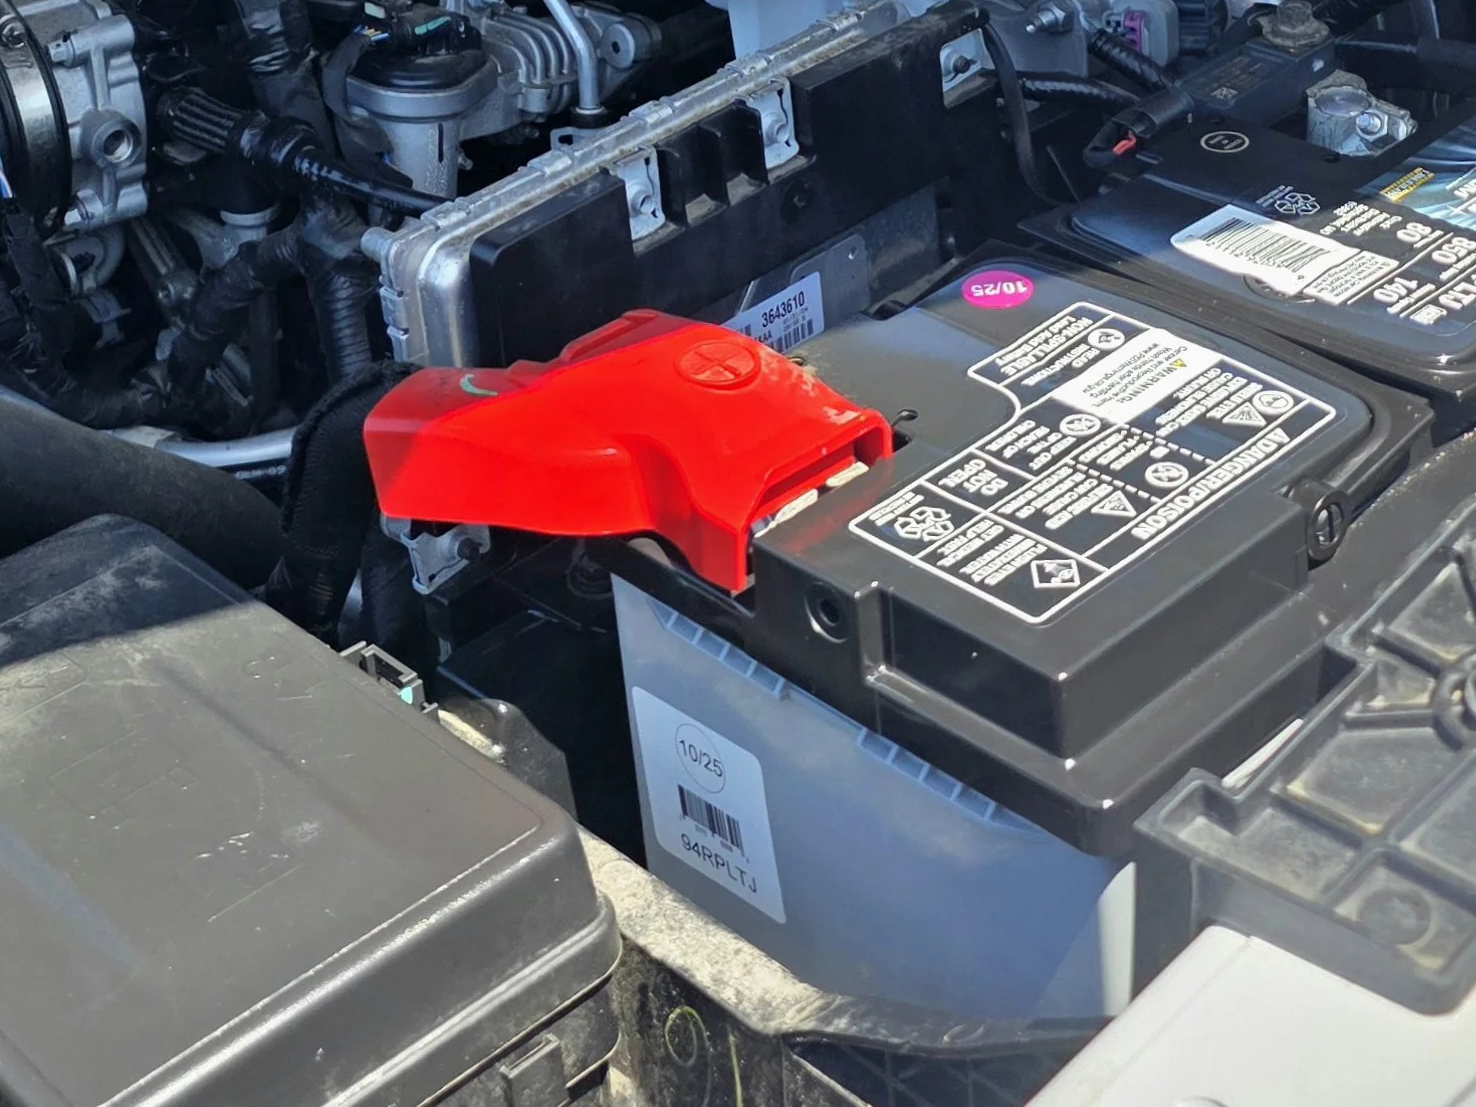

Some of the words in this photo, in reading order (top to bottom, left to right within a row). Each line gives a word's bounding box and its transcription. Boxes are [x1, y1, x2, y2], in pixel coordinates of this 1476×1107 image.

[1396, 222, 1432, 244] 80
[1431, 237, 1476, 264] 850
[970, 280, 1028, 297] 10/25
[1373, 277, 1418, 304] 140
[761, 291, 805, 328] 3643610
[997, 316, 1094, 376] NON-SPILLABLE
[958, 468, 998, 493] NOT
[977, 476, 1010, 497] DO
[1127, 437, 1280, 540] DANGER/POISON
[679, 739, 724, 778] 10/25
[680, 833, 758, 894] 94RPLTJ
